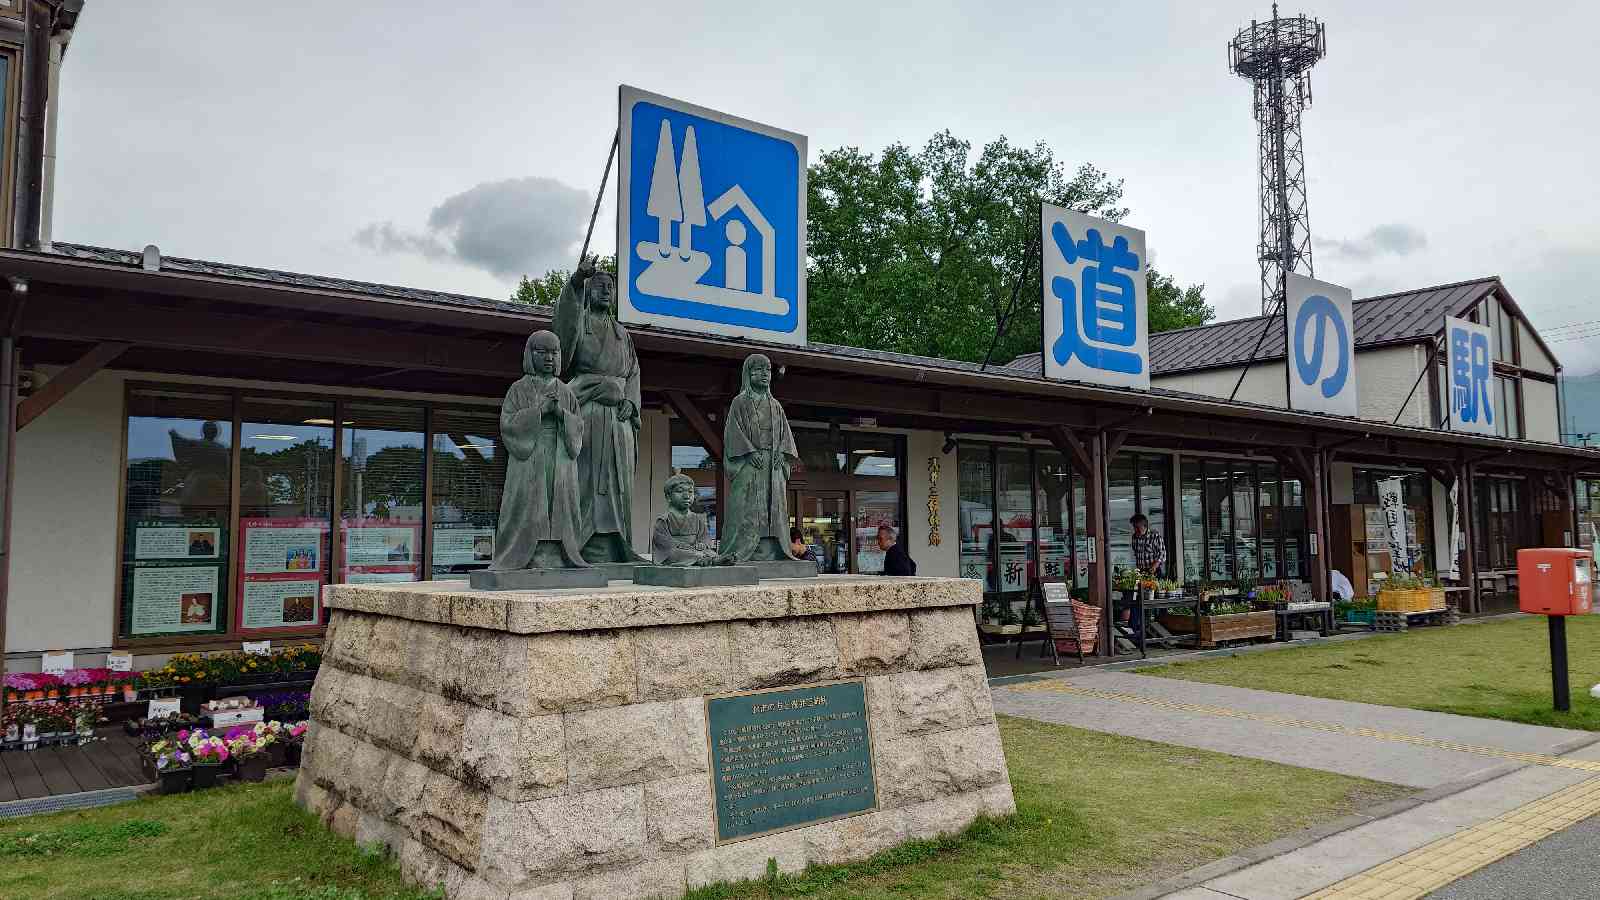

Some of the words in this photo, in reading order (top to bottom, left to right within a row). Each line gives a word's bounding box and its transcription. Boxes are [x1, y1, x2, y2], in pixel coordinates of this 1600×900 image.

[1052, 221, 1143, 375] 道
[1294, 295, 1349, 398] の
[1452, 327, 1493, 425] 駅
